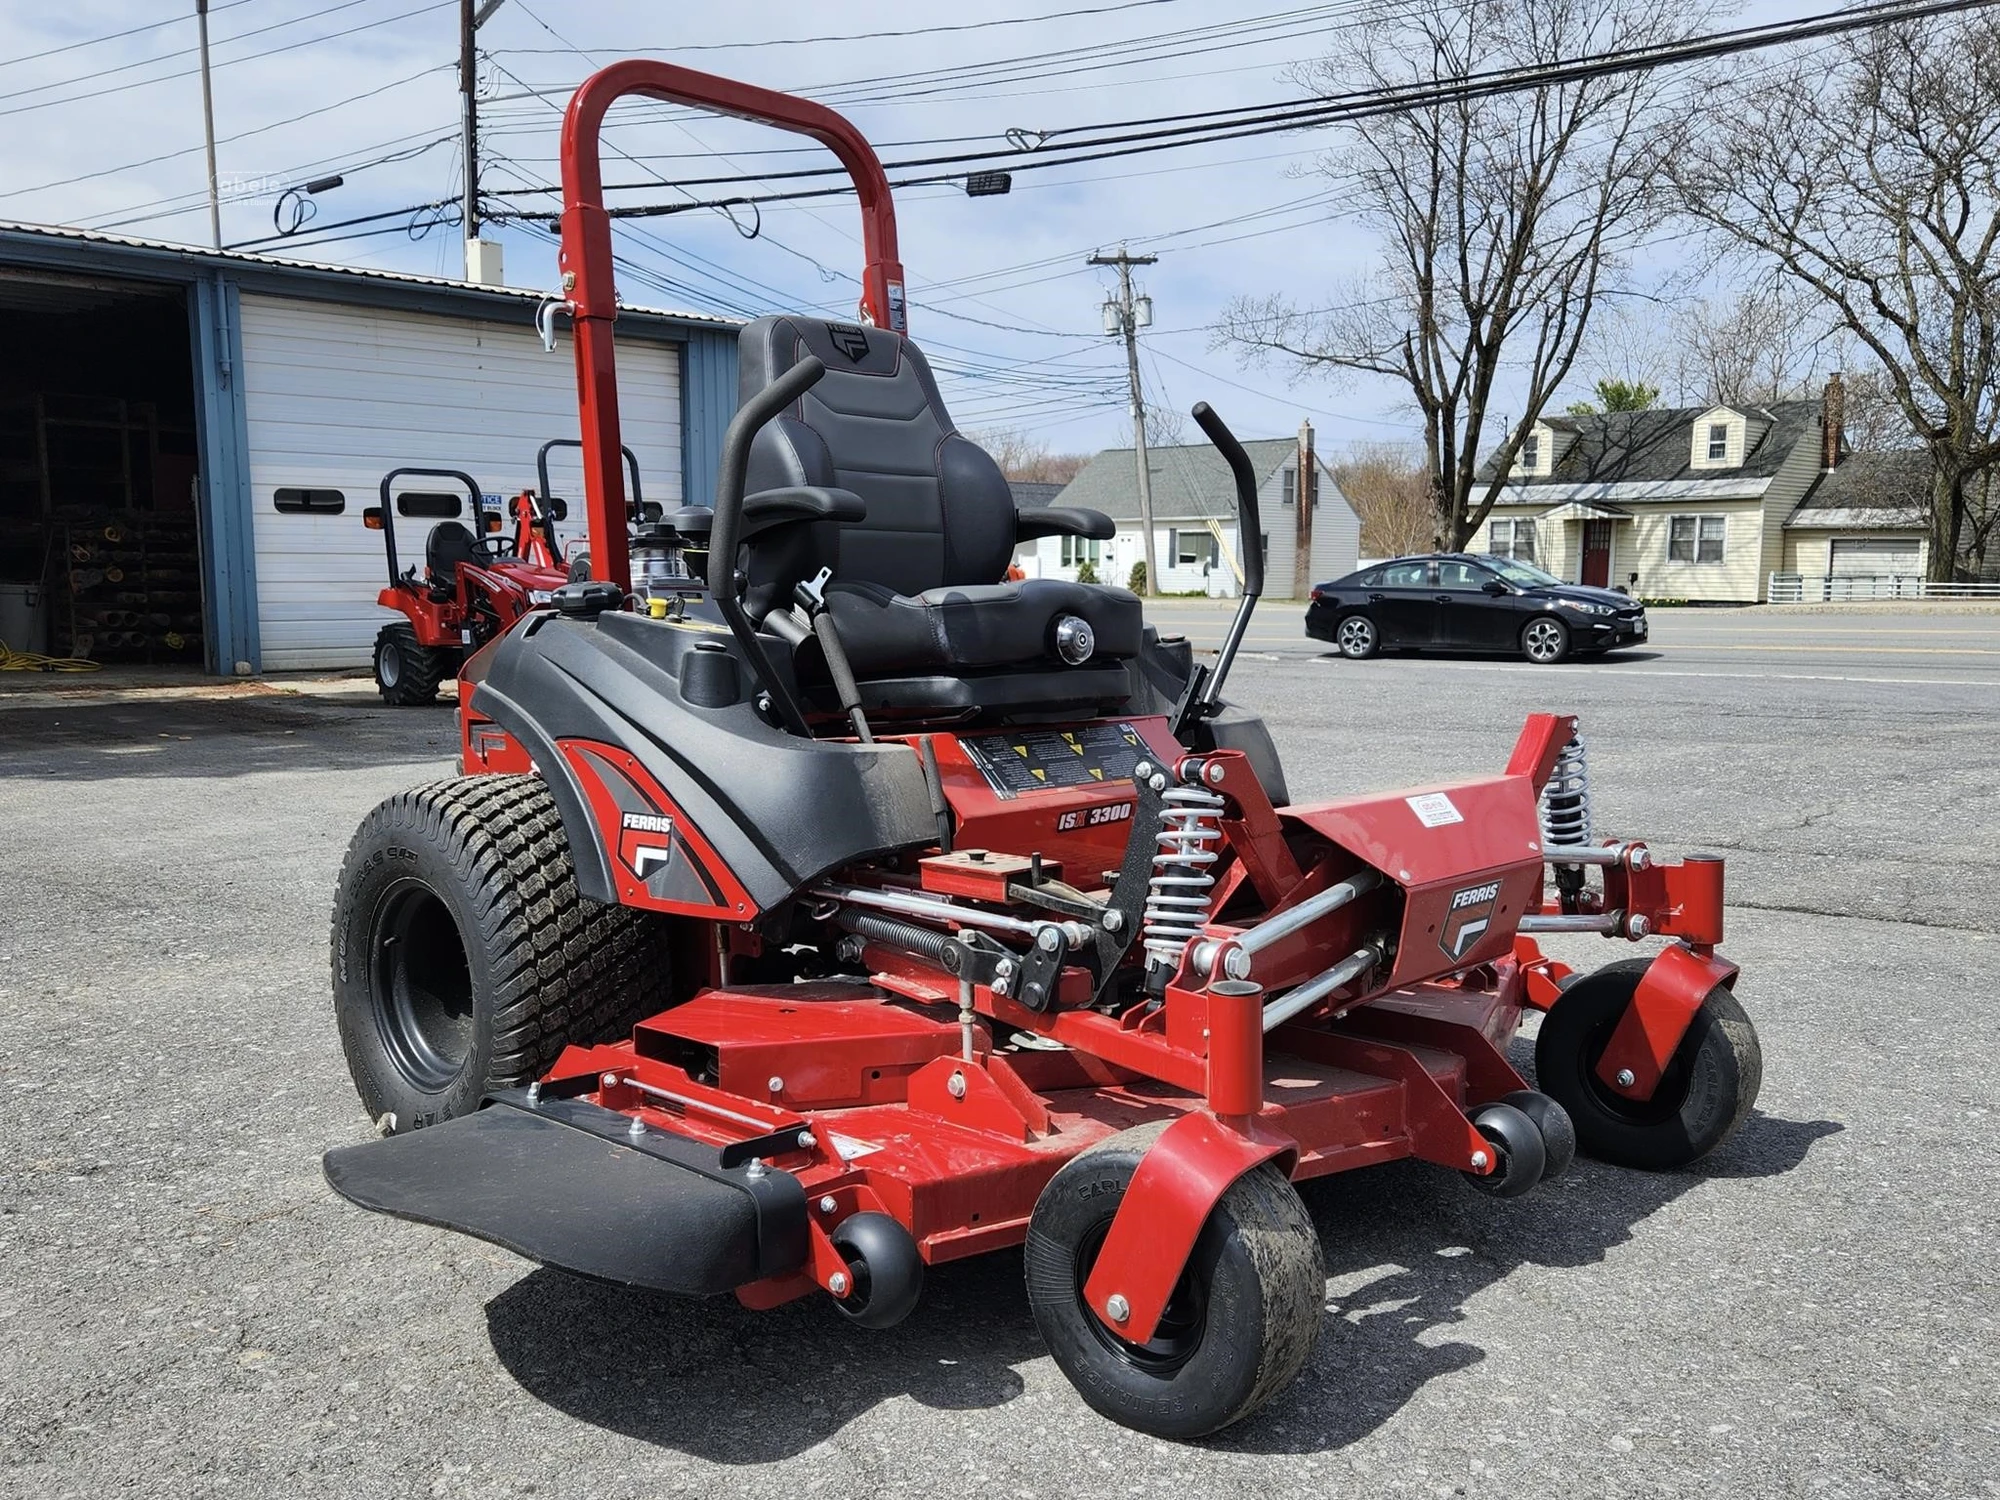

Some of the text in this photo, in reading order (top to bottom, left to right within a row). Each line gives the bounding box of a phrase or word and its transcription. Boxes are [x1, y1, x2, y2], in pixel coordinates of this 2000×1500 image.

[623, 813, 673, 832] FERRIS
[1059, 803, 1132, 831] ISX 3300
[1452, 883, 1498, 909] FERRIS
[1070, 1356, 1186, 1416] RELIANCE
